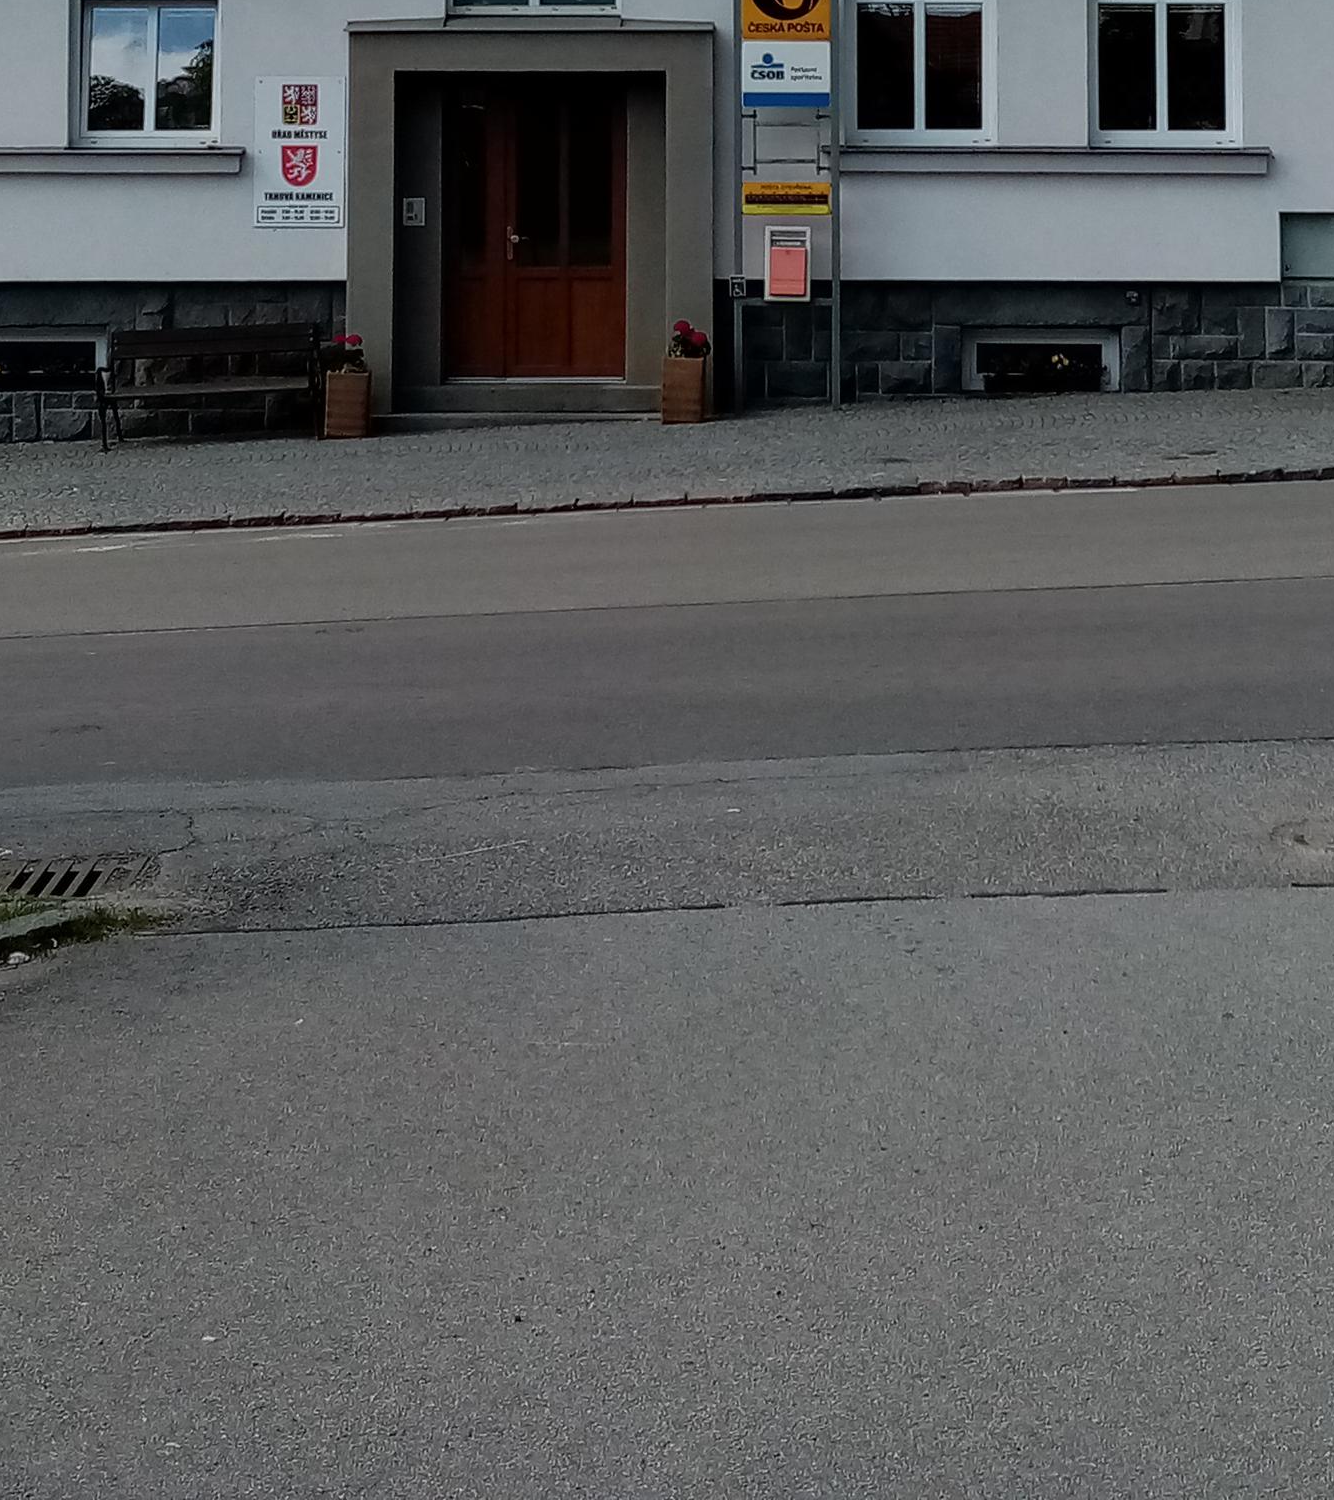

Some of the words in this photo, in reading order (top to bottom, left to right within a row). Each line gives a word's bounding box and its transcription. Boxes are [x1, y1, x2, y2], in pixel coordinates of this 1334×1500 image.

[747, 21, 785, 33] ČESKÁ
[787, 21, 825, 33] POŠTA
[750, 70, 785, 80] ČSOB
[293, 128, 328, 139] MĚSTYSE
[264, 191, 294, 201] TRHOVÁ
[295, 192, 334, 201] KAMENICE
